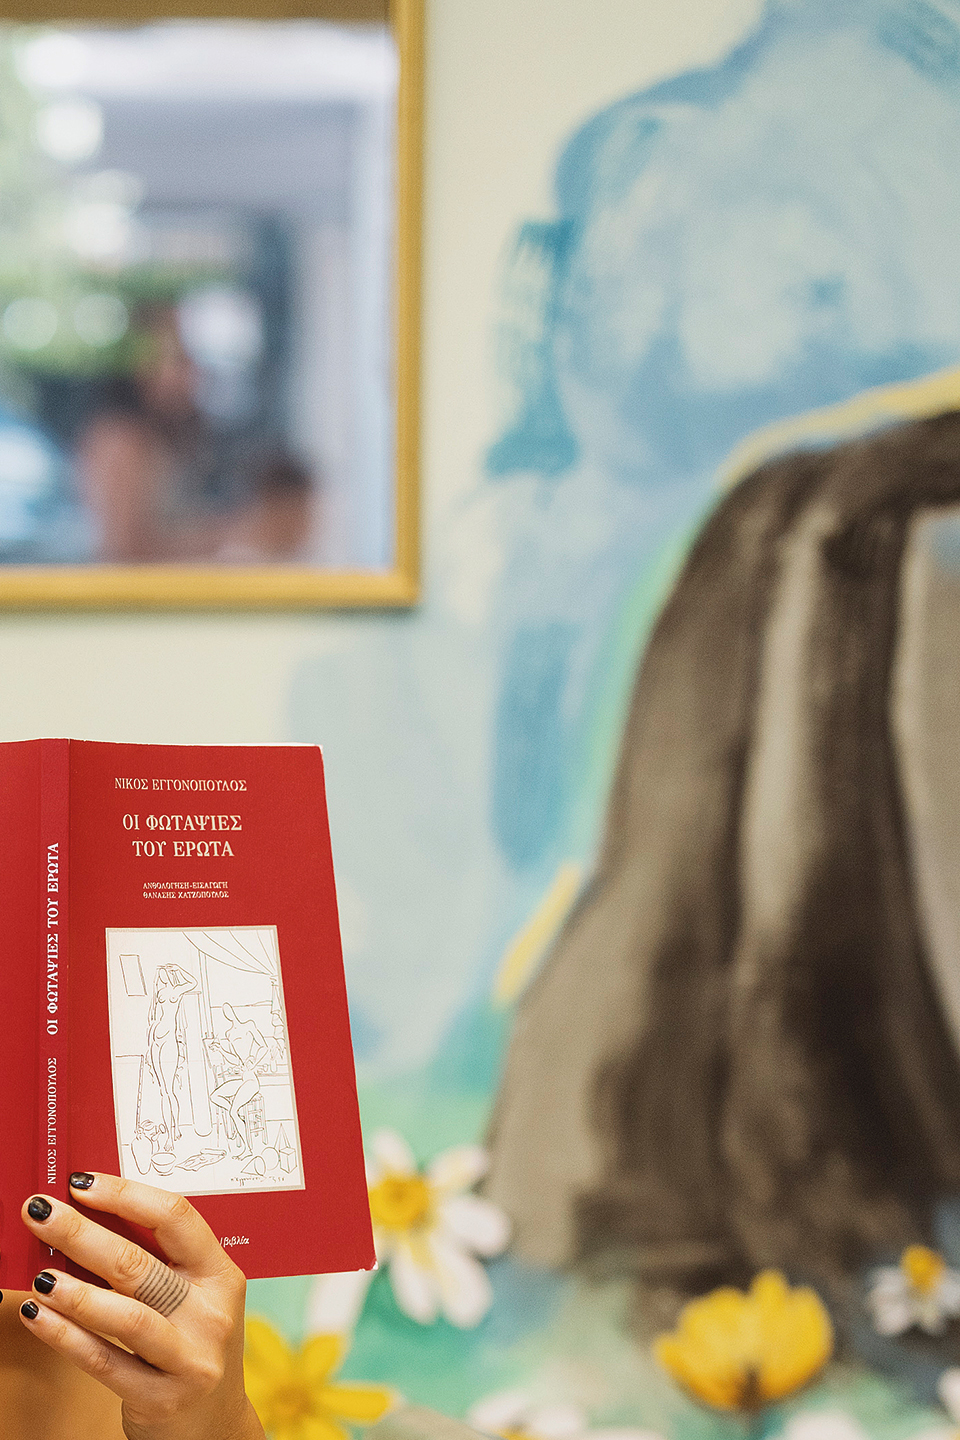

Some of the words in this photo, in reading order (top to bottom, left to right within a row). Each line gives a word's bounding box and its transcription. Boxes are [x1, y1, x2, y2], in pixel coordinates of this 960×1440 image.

[114, 777, 149, 790] ΝΙΚΟΣ
[152, 778, 247, 792] ΕΓΓΟΝΟΠΟΥΛΟΣ
[122, 813, 140, 831] ΟΙ
[145, 814, 243, 831] ΦΩΤΑΨΙΕΣ
[131, 840, 167, 857] ΤΟΥ
[173, 840, 235, 857] ΕΡΩΤΑ
[47, 842, 59, 893] ΕΡΩΤΑ
[47, 897, 59, 929] ΤΟΥ
[46, 933, 59, 1015] ΦΩΤΑΨΙΕΣ
[46, 1018, 58, 1036] ΟΙ
[47, 1057, 58, 1146] ΕΓΓΟΝΟΠΟΥΛΟΣ
[47, 1148, 57, 1185] ΝΙΚΟΣ
